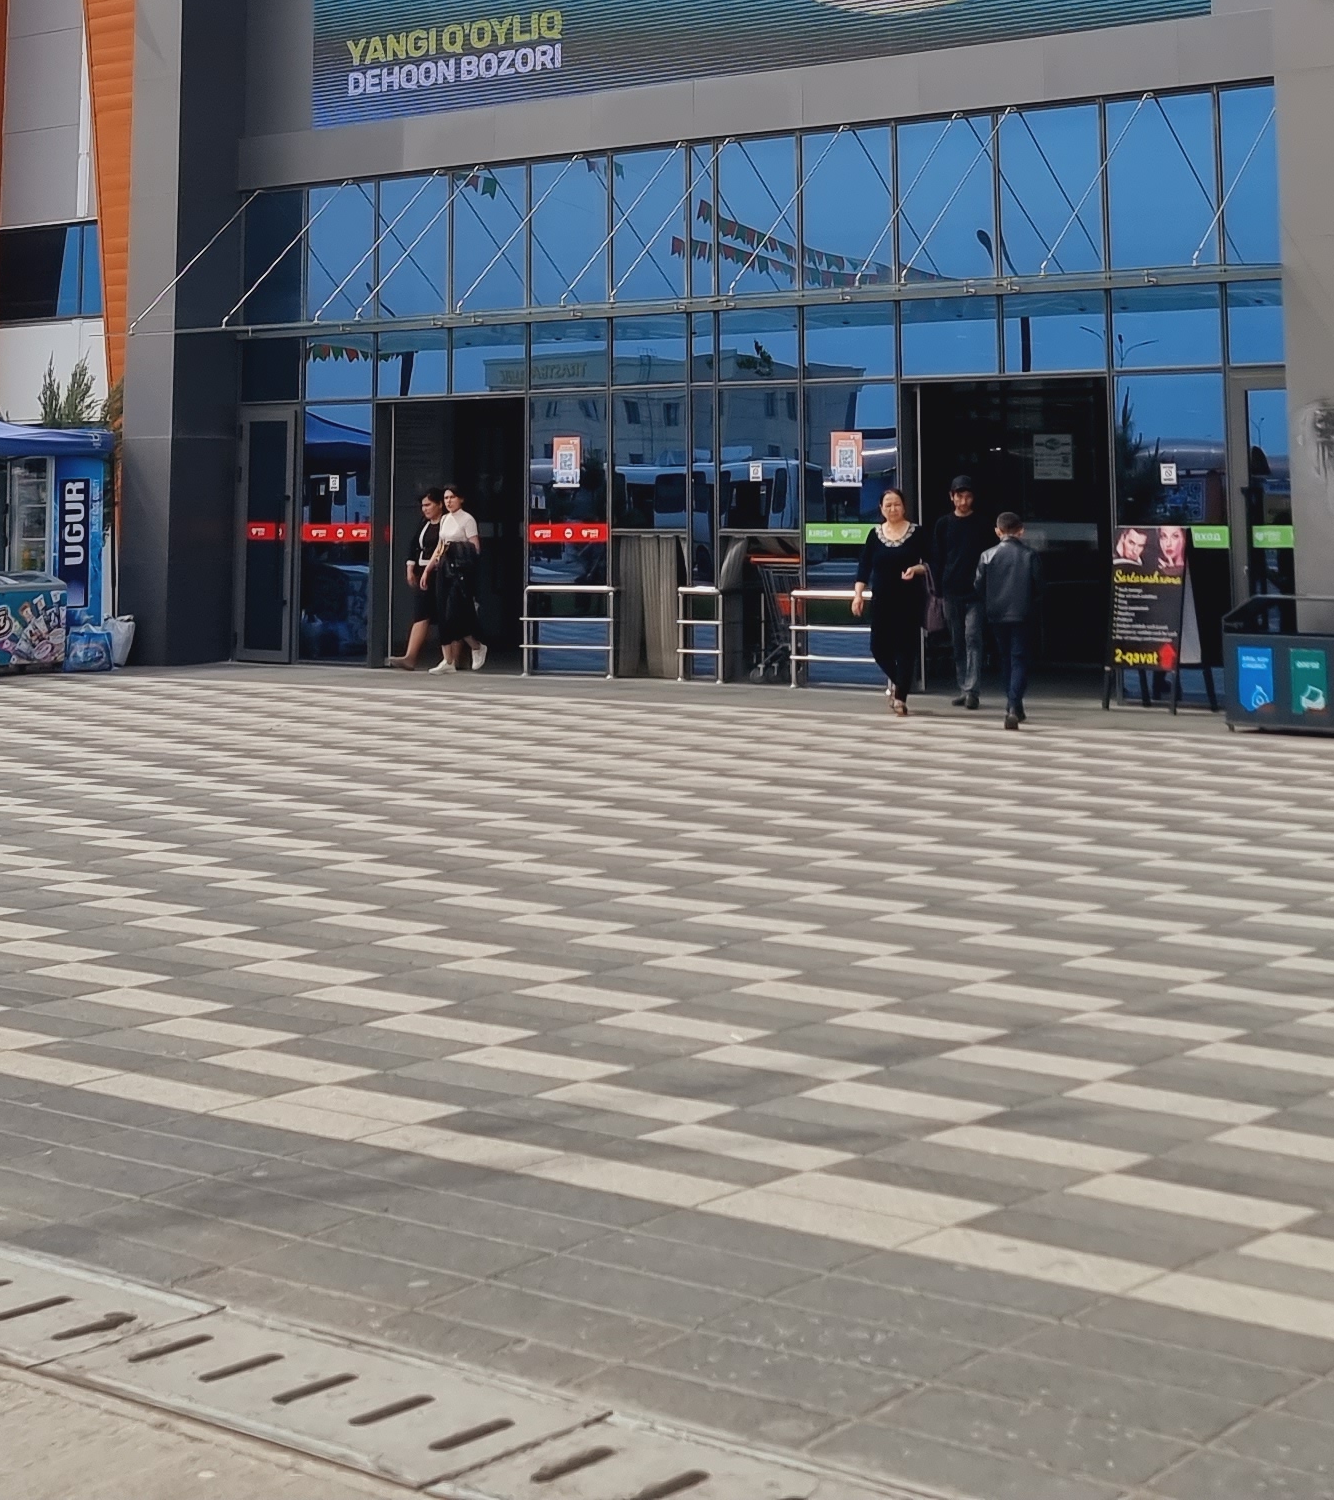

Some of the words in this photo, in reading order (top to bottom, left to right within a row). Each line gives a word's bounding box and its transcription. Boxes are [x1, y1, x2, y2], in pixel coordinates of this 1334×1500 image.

[346, 27, 437, 66] YANGI
[347, 57, 456, 97] DEHQON
[460, 43, 562, 81] BOZORI
[1114, 648, 1158, 666] 2-qavat
